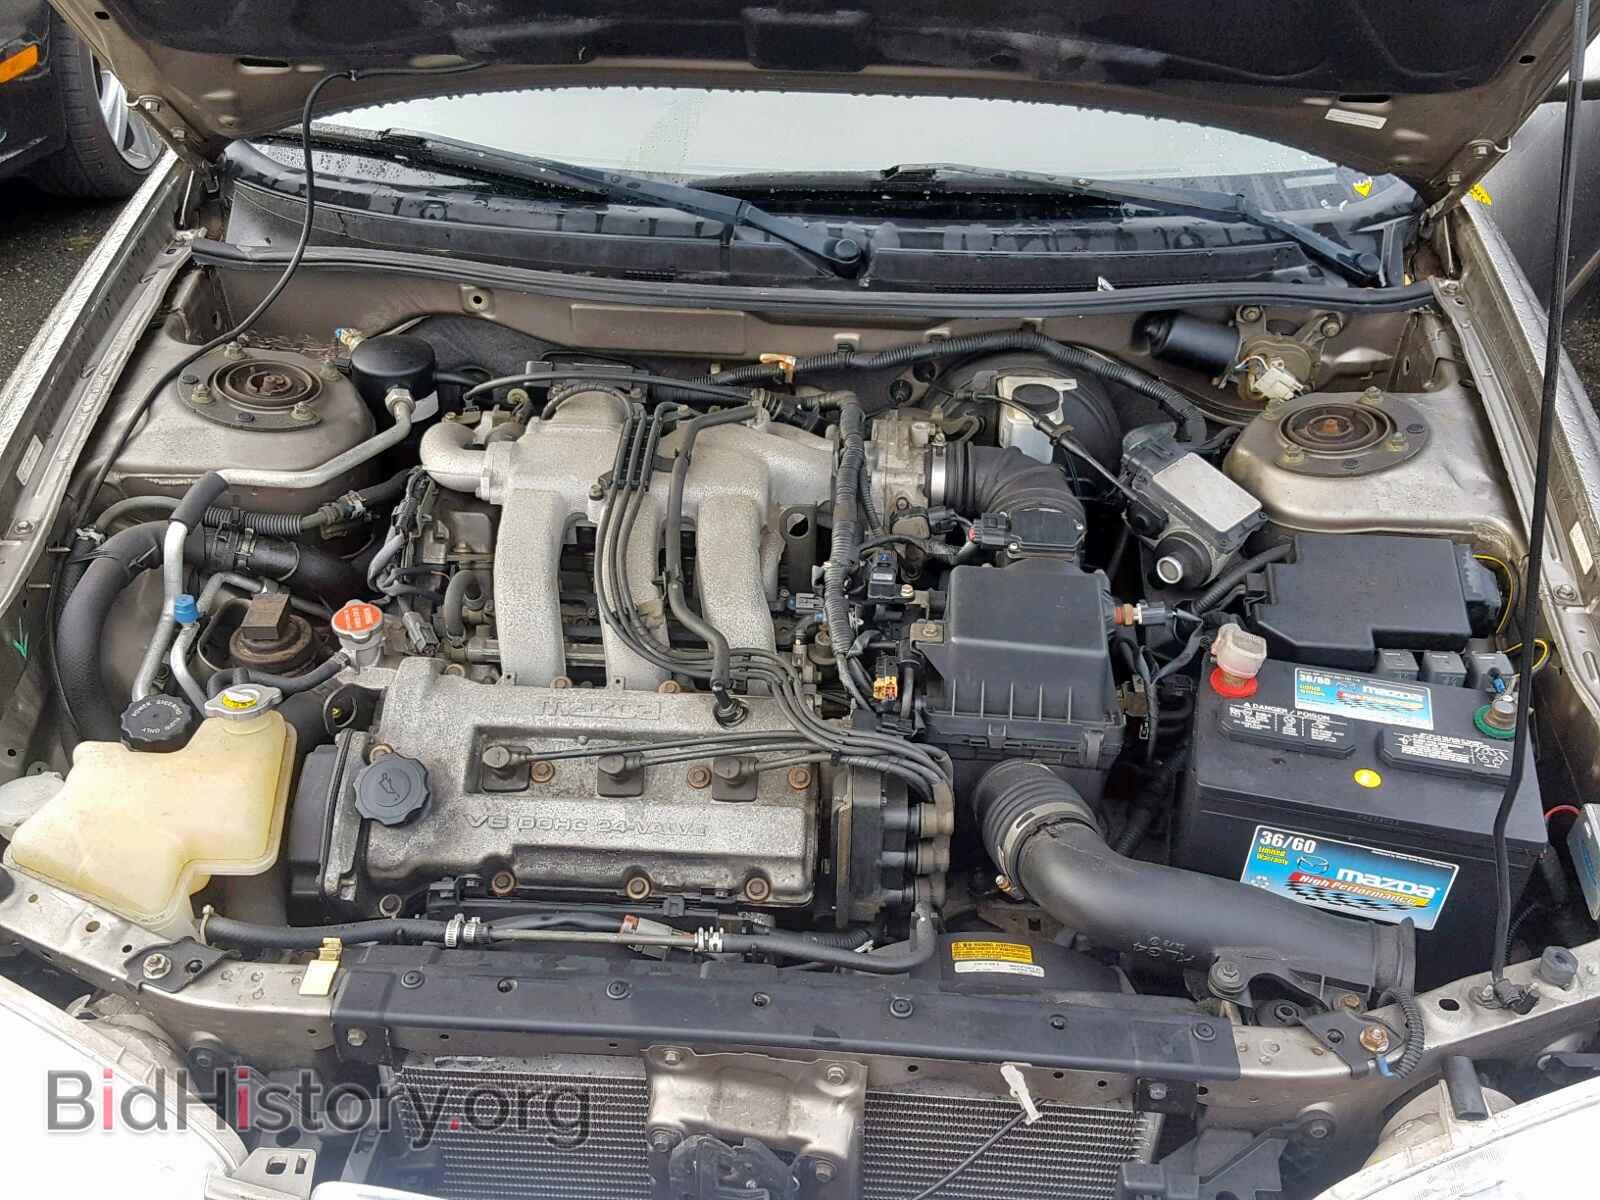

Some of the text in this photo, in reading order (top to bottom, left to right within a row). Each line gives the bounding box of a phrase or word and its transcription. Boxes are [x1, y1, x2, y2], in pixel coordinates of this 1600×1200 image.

[1252, 703, 1289, 715] DANGER
[1296, 710, 1331, 721] POISON
[463, 813, 509, 830] V6
[517, 815, 589, 833] DOHC
[1259, 830, 1317, 855] 36/60
[1299, 874, 1418, 906] High Performance
[1336, 867, 1437, 899] mazda
